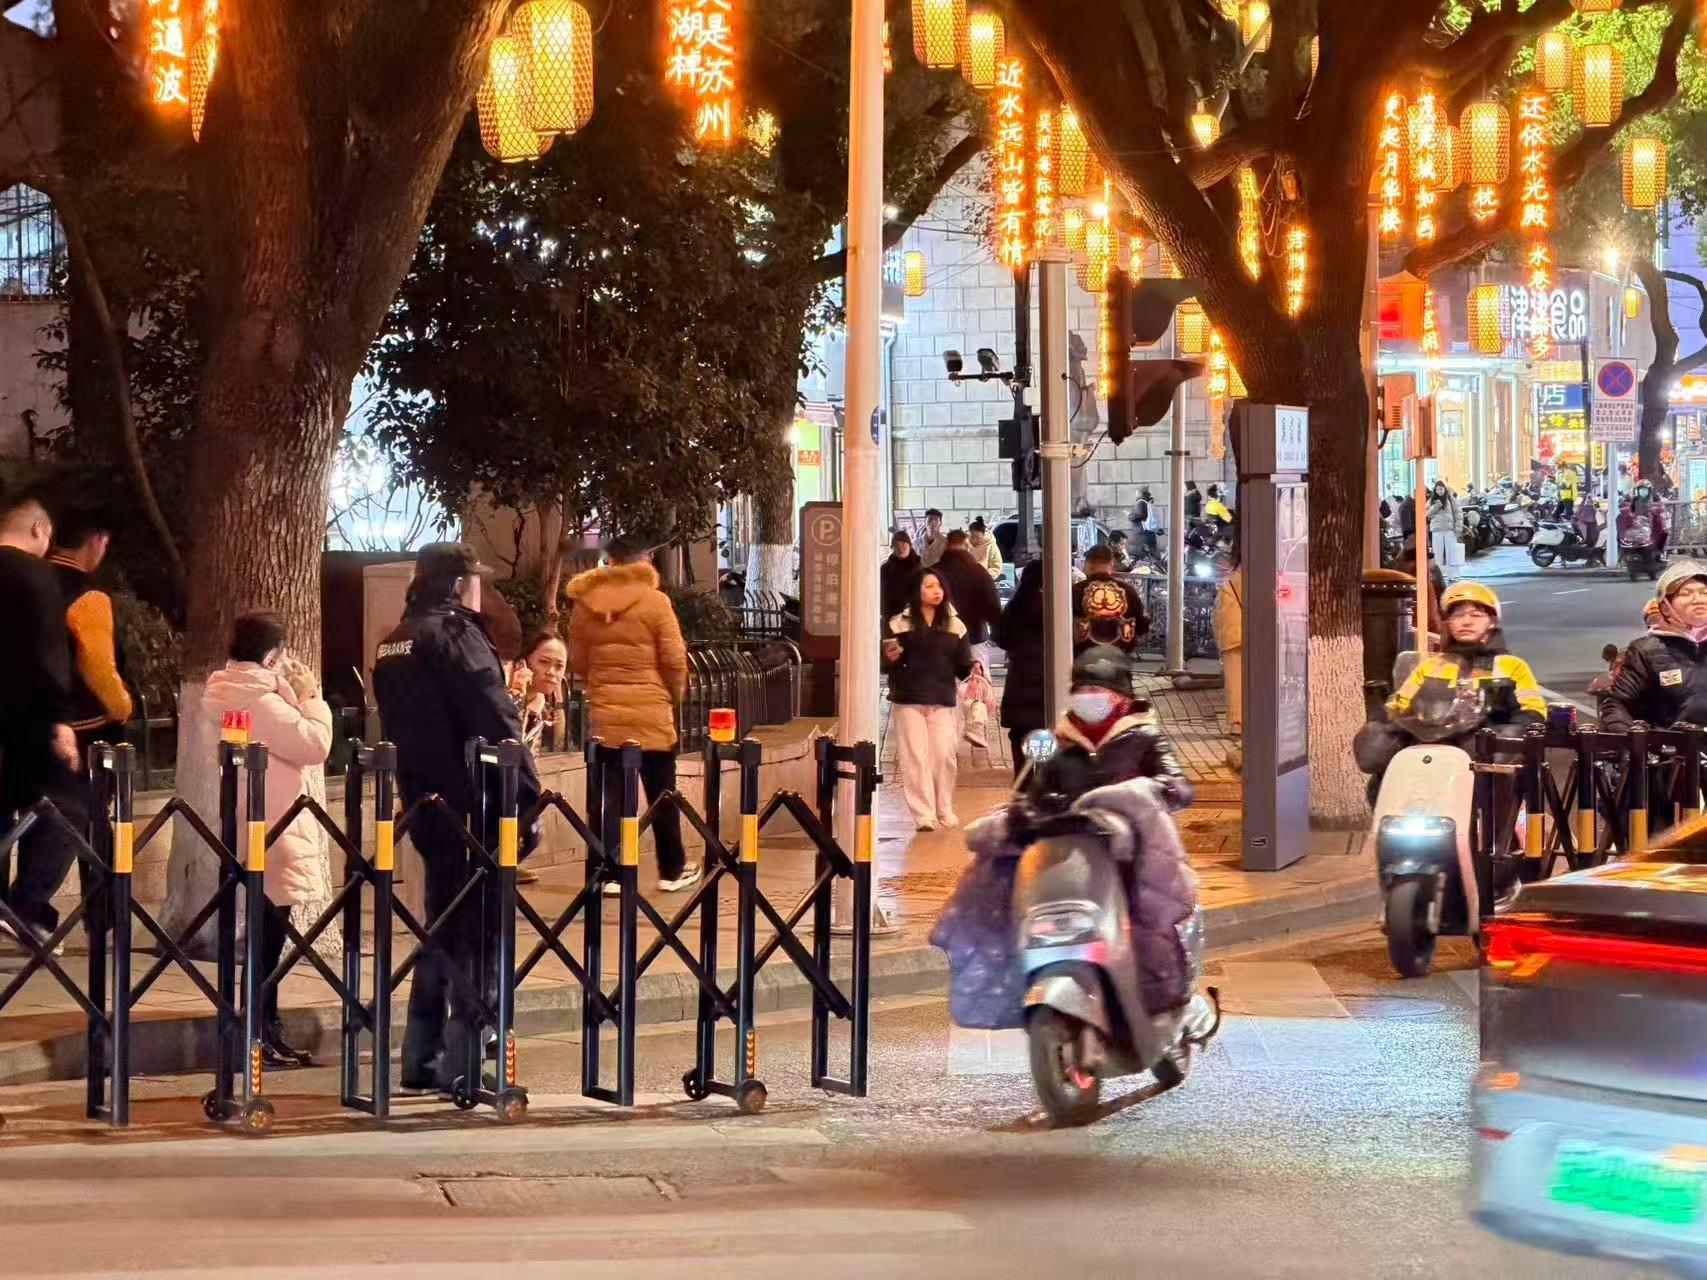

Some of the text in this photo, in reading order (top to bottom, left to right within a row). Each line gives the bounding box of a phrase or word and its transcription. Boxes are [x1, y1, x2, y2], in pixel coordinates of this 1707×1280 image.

[998, 61, 1025, 265] 近水远山皆有情
[1520, 97, 1548, 228] 还依水光殿
[819, 519, 835, 541] P
